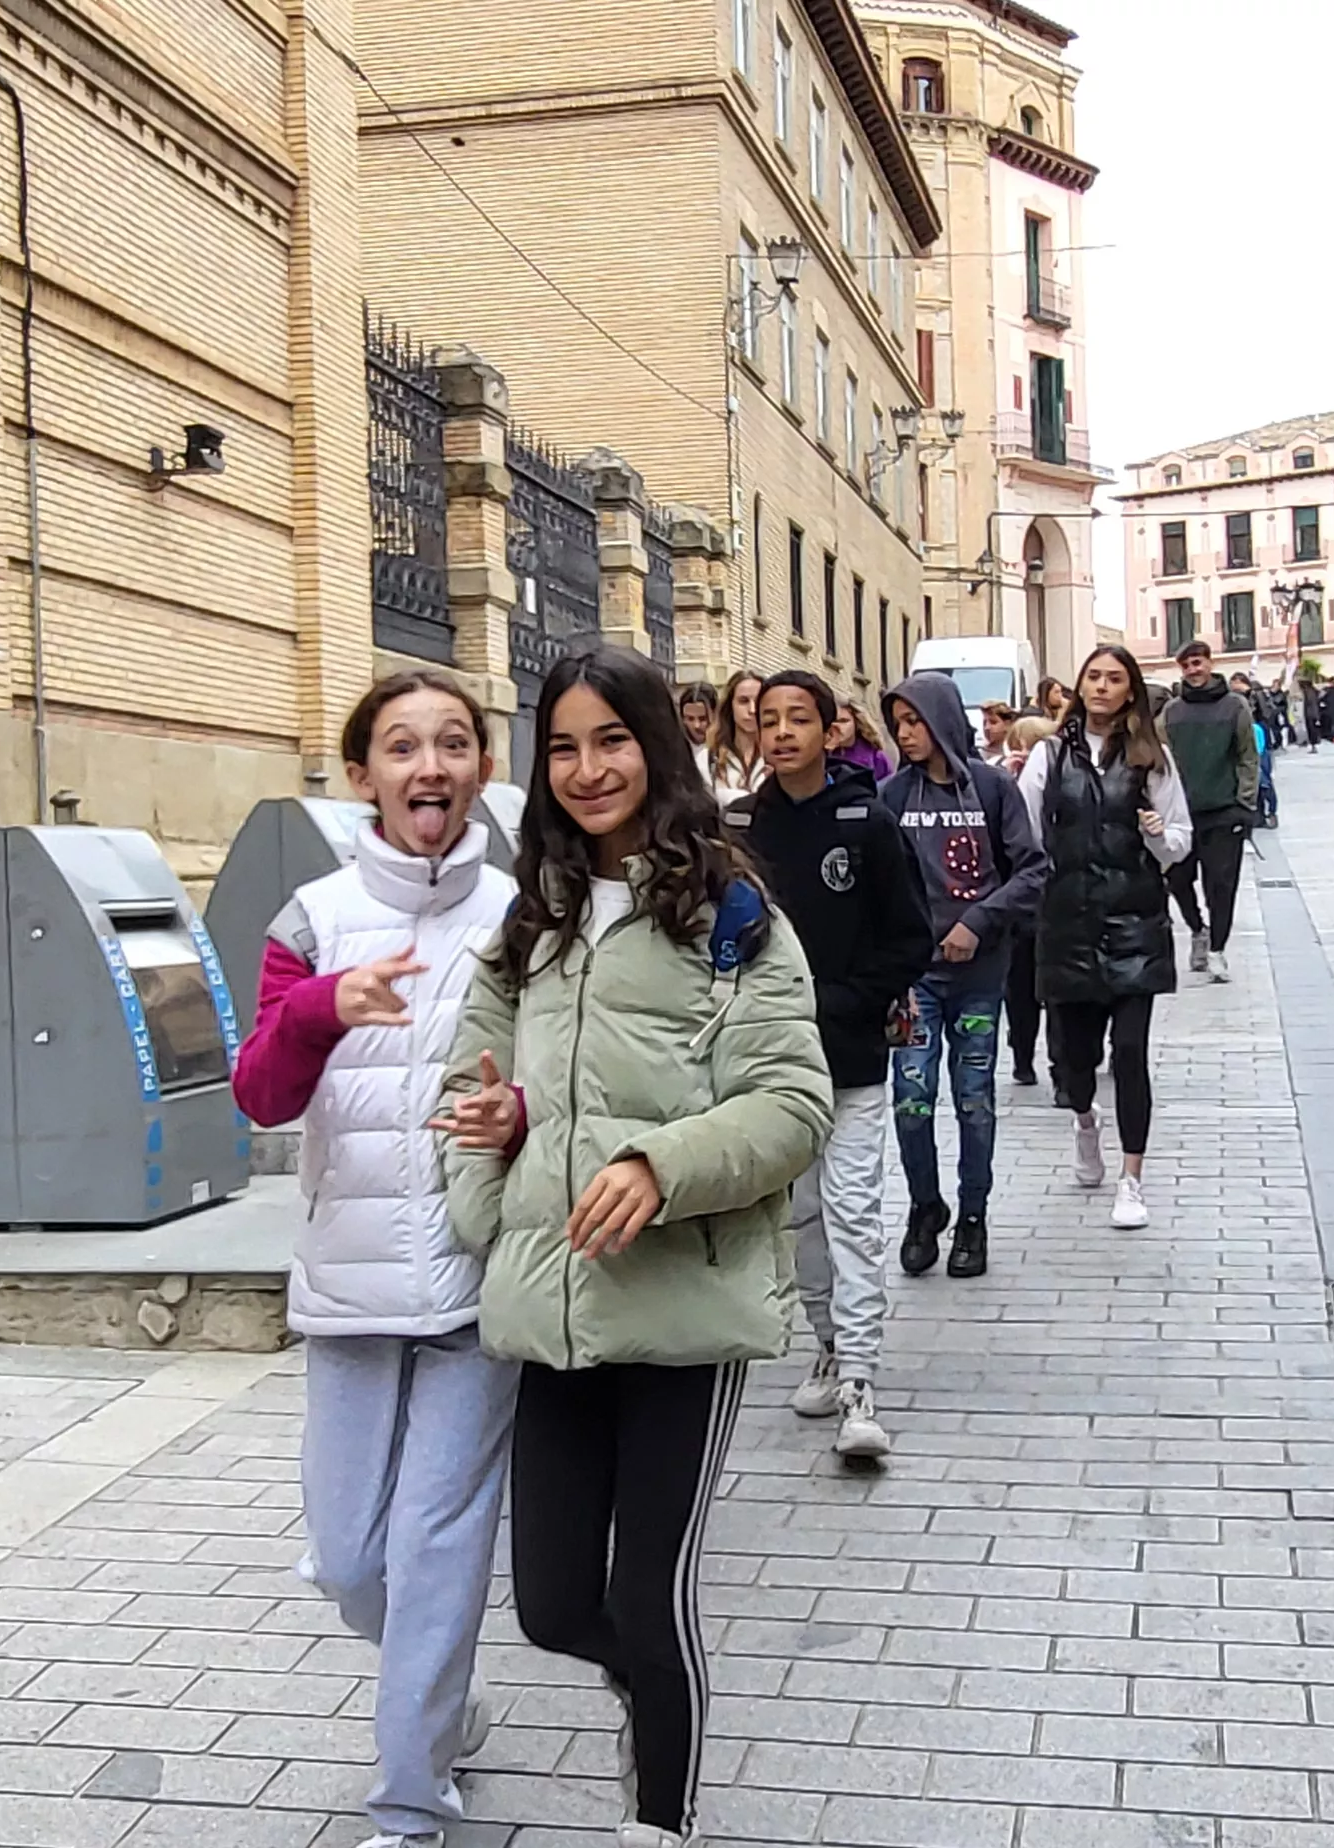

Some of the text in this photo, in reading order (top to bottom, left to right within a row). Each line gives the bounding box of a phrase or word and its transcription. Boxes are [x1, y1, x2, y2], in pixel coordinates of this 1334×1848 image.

[899, 811, 986, 827] NEW YORK
[133, 1018, 156, 1092] PAPEL
